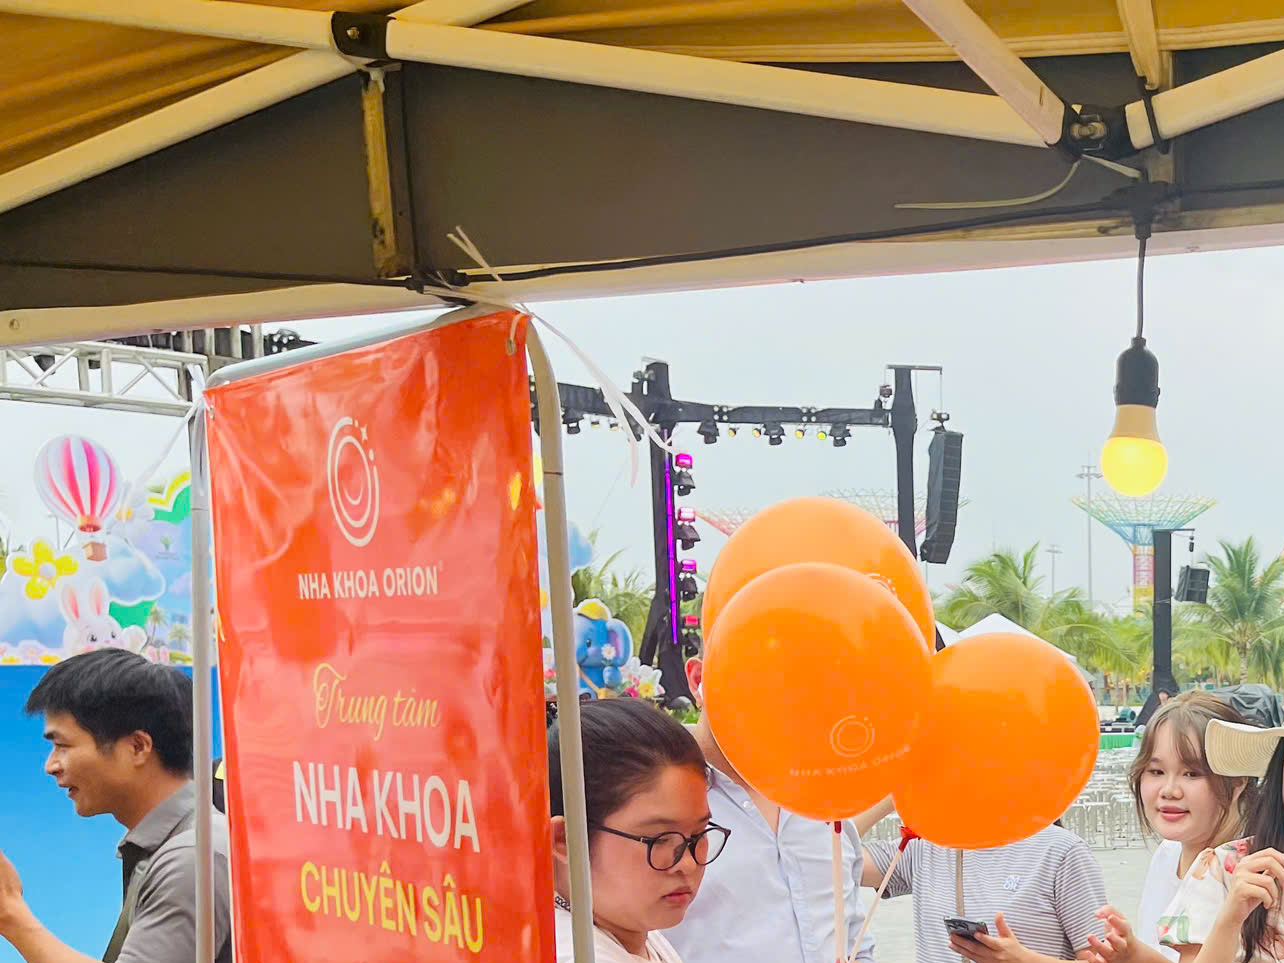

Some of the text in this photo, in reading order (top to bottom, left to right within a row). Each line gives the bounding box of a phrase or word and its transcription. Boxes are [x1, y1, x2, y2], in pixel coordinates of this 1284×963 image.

[298, 566, 438, 600] NHA KHOA ORION
[313, 662, 440, 742] Trung tâm
[293, 760, 481, 853] NHA KHOA
[300, 860, 484, 954] CHUYÊN SÂU
